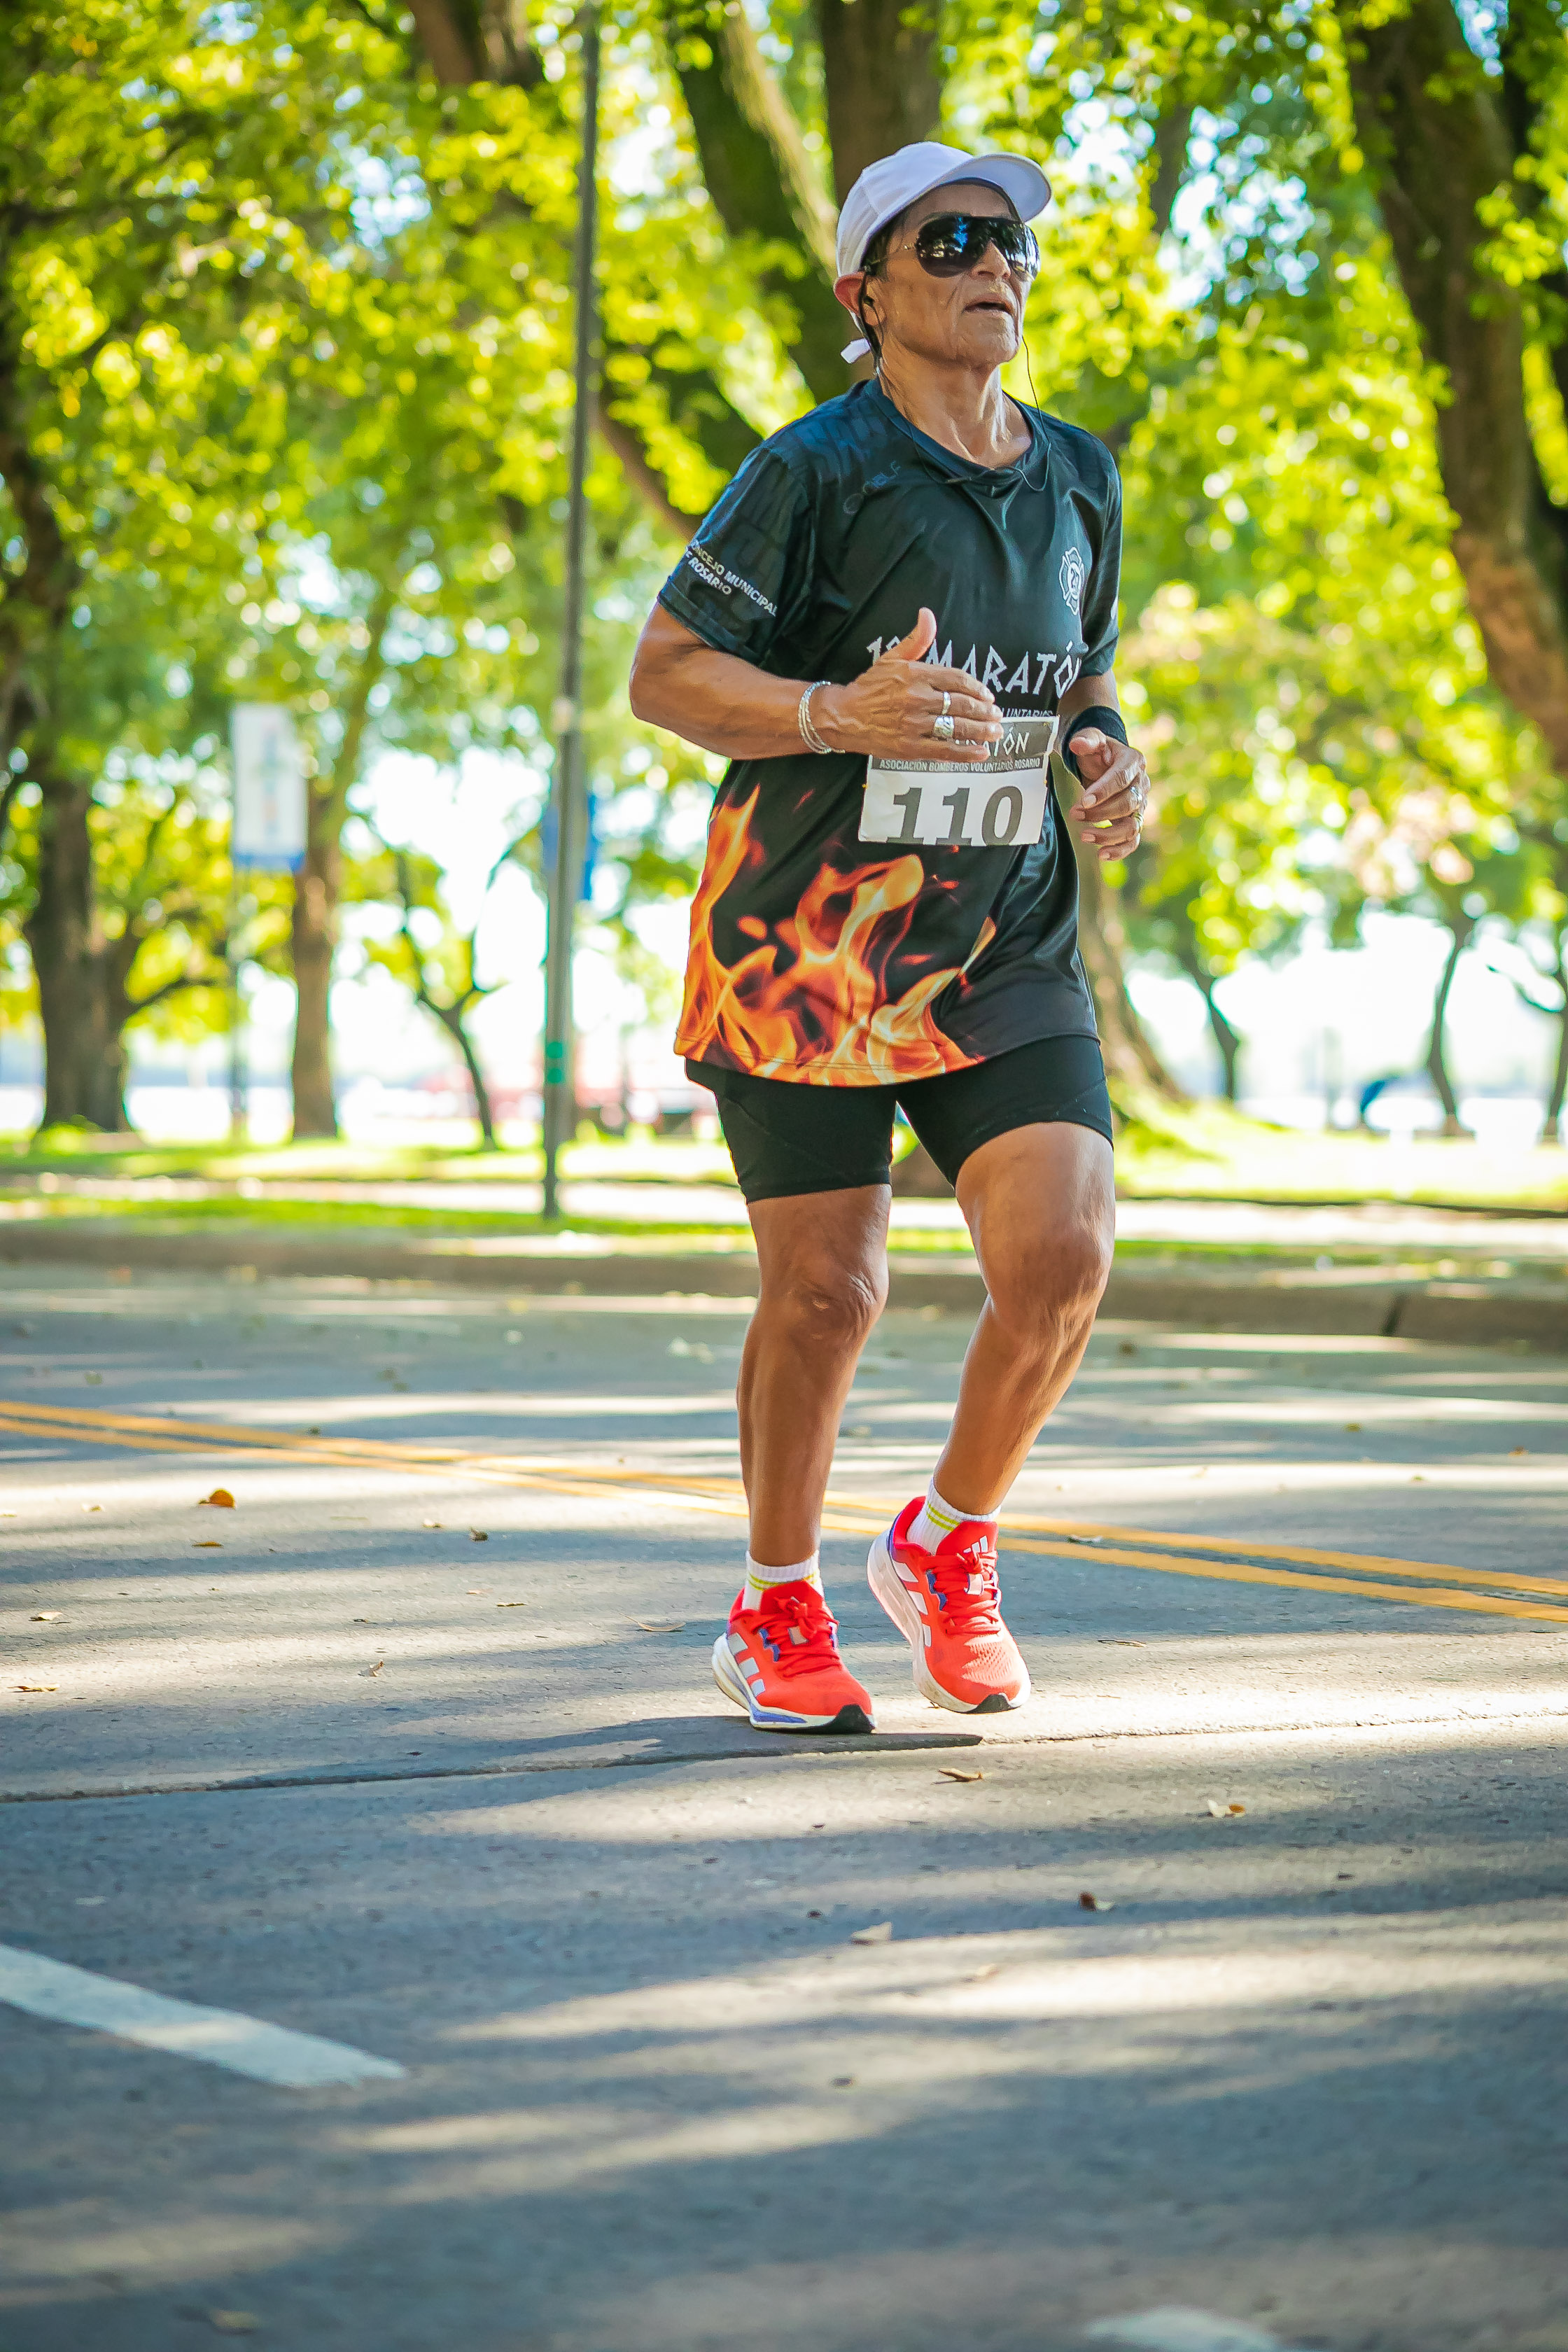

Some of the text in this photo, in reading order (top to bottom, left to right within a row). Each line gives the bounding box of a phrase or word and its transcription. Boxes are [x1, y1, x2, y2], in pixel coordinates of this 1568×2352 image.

[688, 556, 732, 595] ROSARIO
[724, 570, 778, 617] MUNICIPAL
[928, 761, 969, 772] BOMBEROS
[970, 760, 1014, 772] VOLUNTARIOS
[1015, 758, 1040, 769] ROSARIO
[886, 785, 1023, 846] 110
